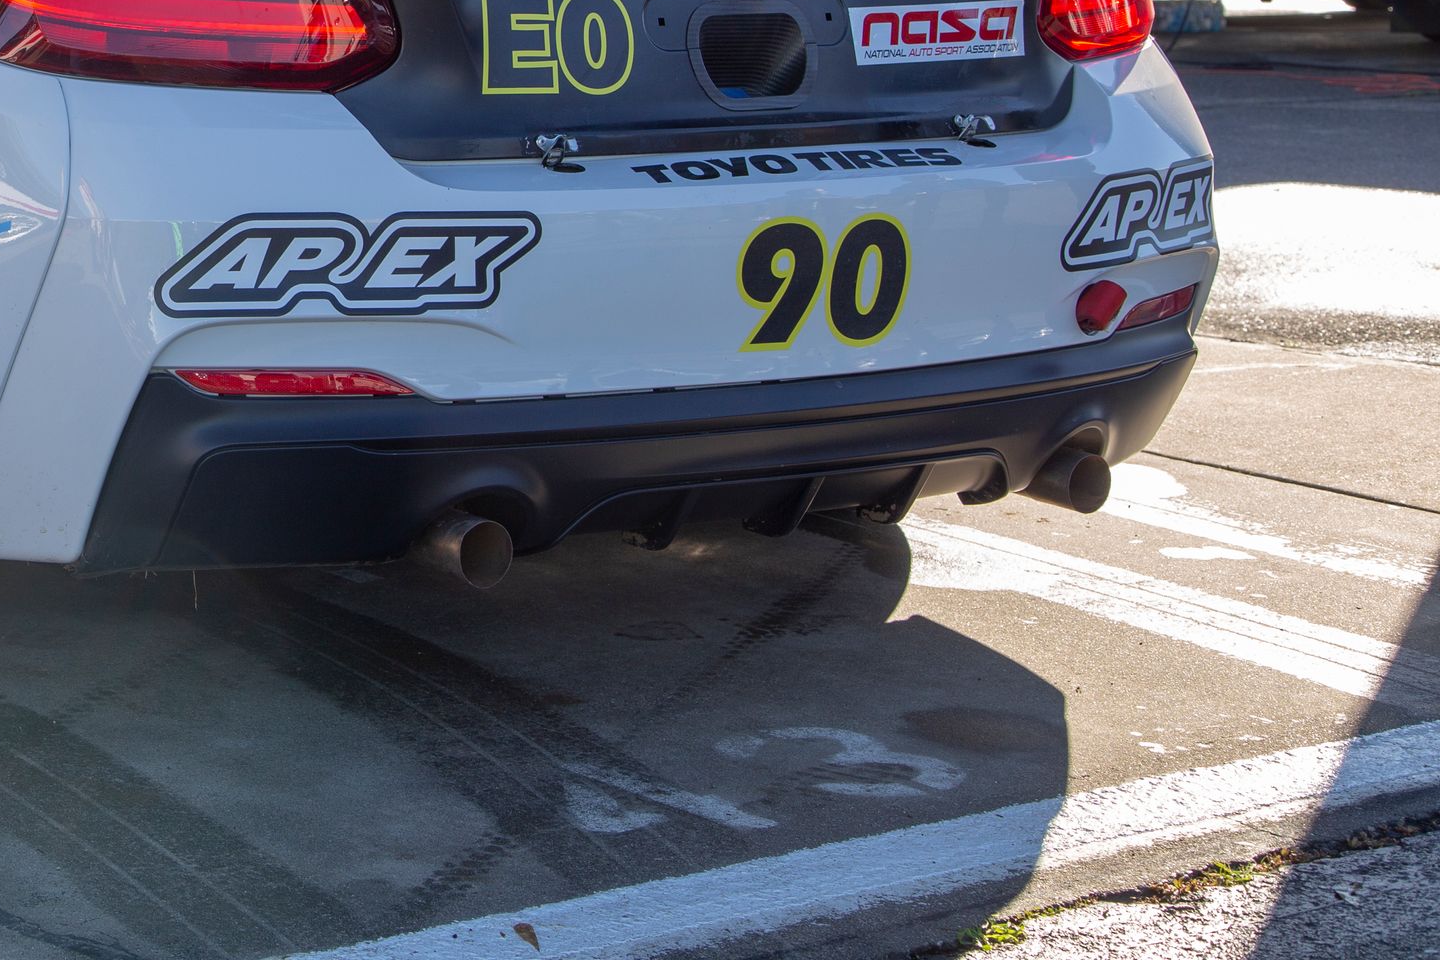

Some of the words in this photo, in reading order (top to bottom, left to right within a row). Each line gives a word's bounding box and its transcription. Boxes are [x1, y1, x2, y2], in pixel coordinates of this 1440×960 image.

[861, 6, 1018, 47] nasa
[864, 48, 907, 59] NATIONAL
[908, 47, 933, 57] AUTO
[935, 45, 964, 56] SPORT
[965, 42, 1019, 54] ASSOCIATION
[630, 153, 798, 184] TOYO
[792, 147, 963, 171] TIRES
[736, 211, 911, 353] 90
